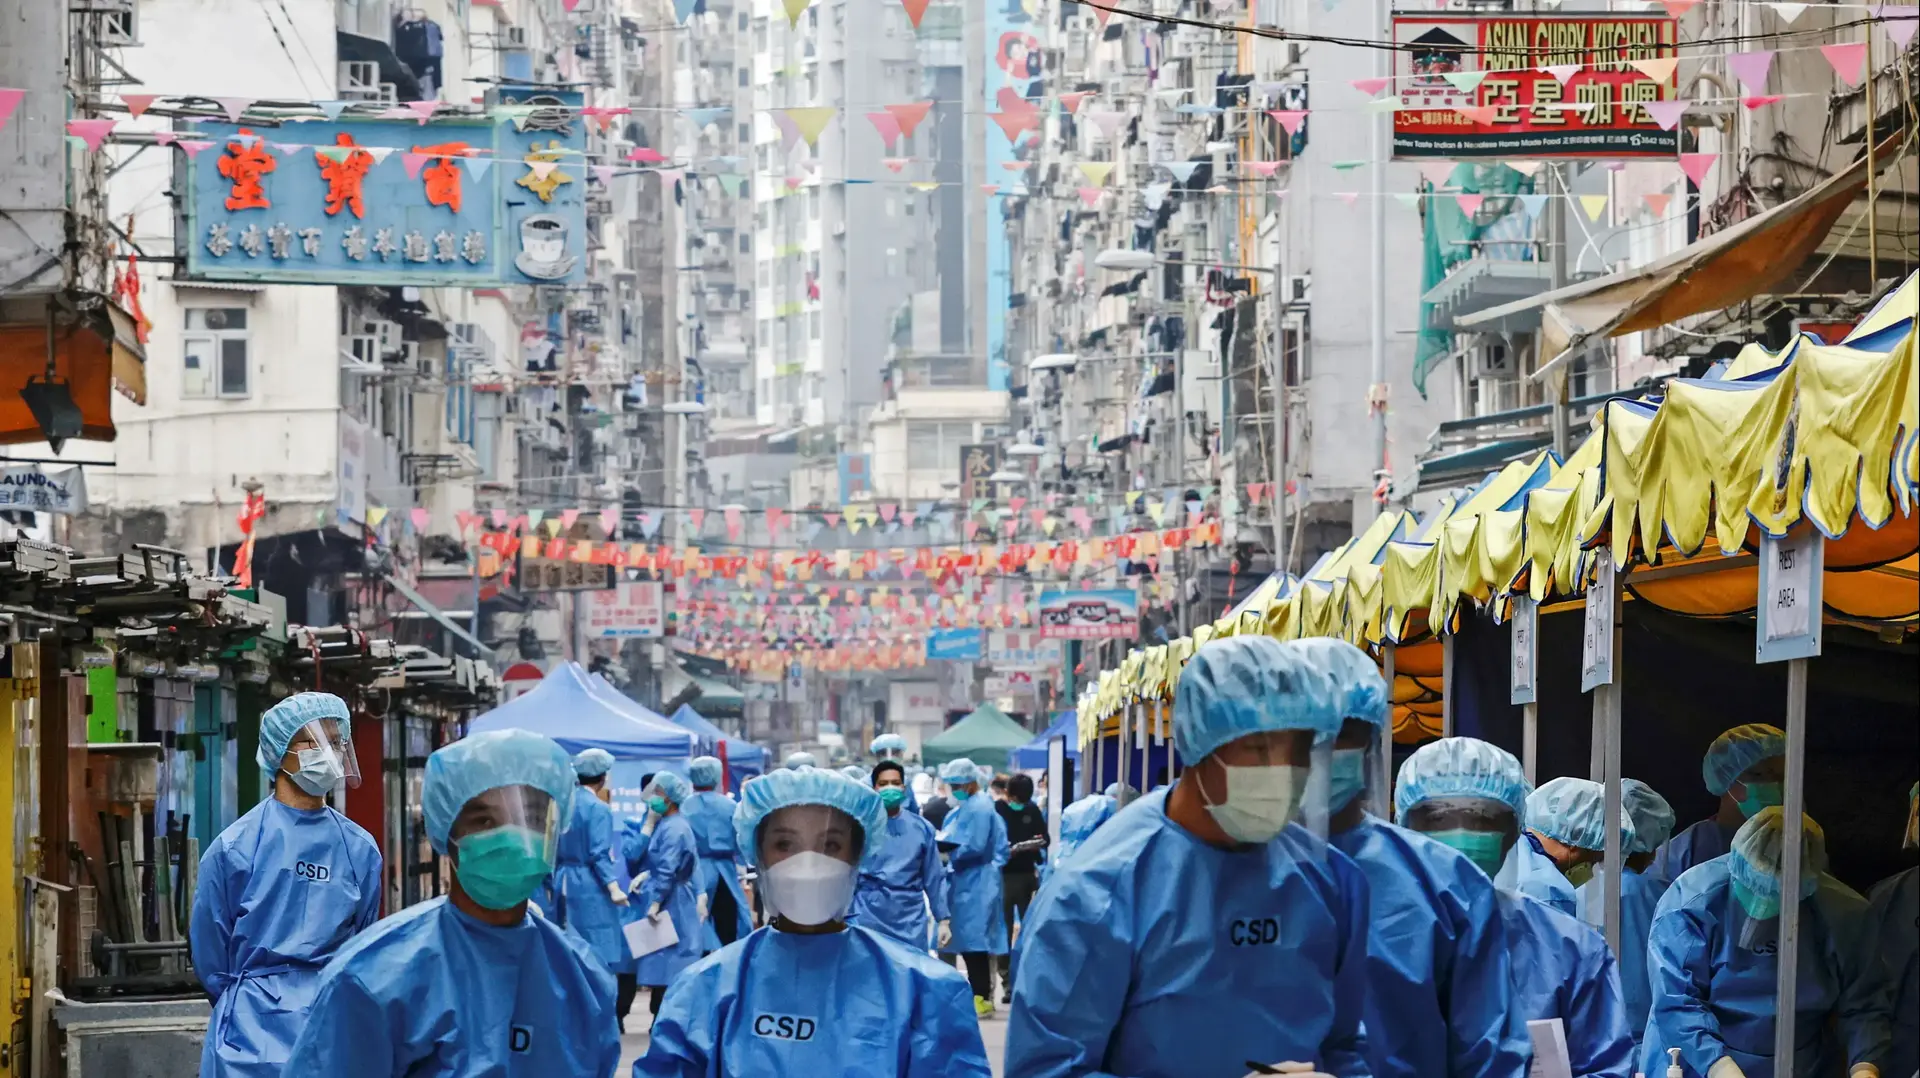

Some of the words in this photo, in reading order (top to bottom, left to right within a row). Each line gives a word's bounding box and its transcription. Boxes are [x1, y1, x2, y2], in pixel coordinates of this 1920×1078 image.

[1484, 22, 1528, 71] ASIAN
[1535, 22, 1586, 73] CURRY
[1592, 22, 1657, 73] KITCHEN
[1483, 79, 1658, 125] 亞星咖喱
[1543, 138, 1561, 146] Food
[1779, 549, 1795, 570] REST
[1778, 588, 1795, 609] AREA
[296, 861, 329, 879] CSD
[1230, 918, 1279, 946] CSD
[1752, 940, 1778, 954] CS
[754, 1014, 816, 1040] CSD
